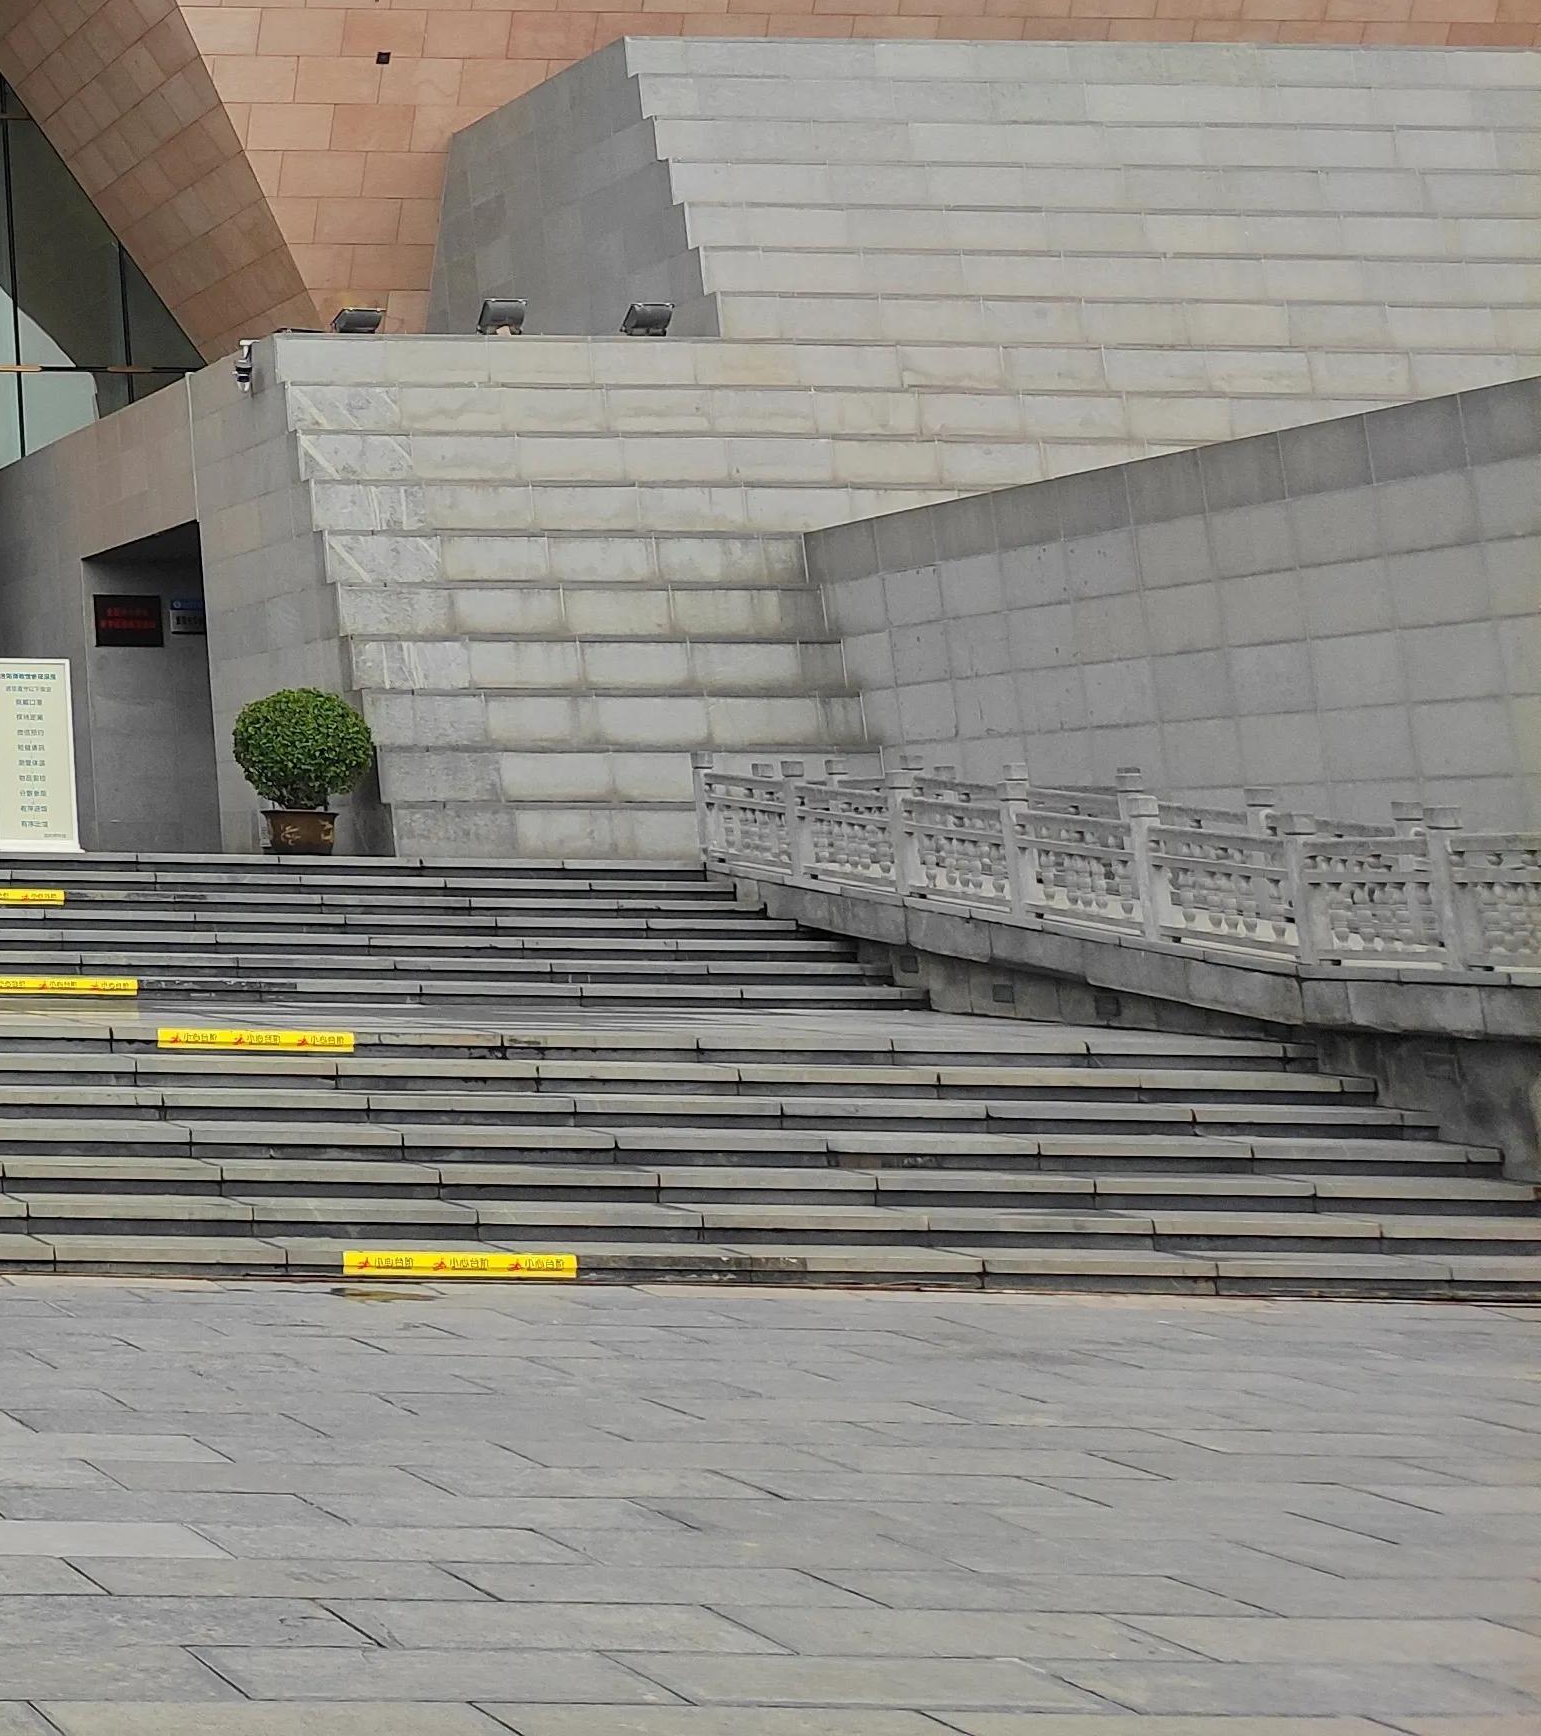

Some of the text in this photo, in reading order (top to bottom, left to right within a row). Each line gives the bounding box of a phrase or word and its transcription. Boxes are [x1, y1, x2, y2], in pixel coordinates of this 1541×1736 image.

[374, 1256, 415, 1270] 小心台阶
[449, 1257, 490, 1271] 小心台阶
[524, 1258, 565, 1272] 小心台阶
